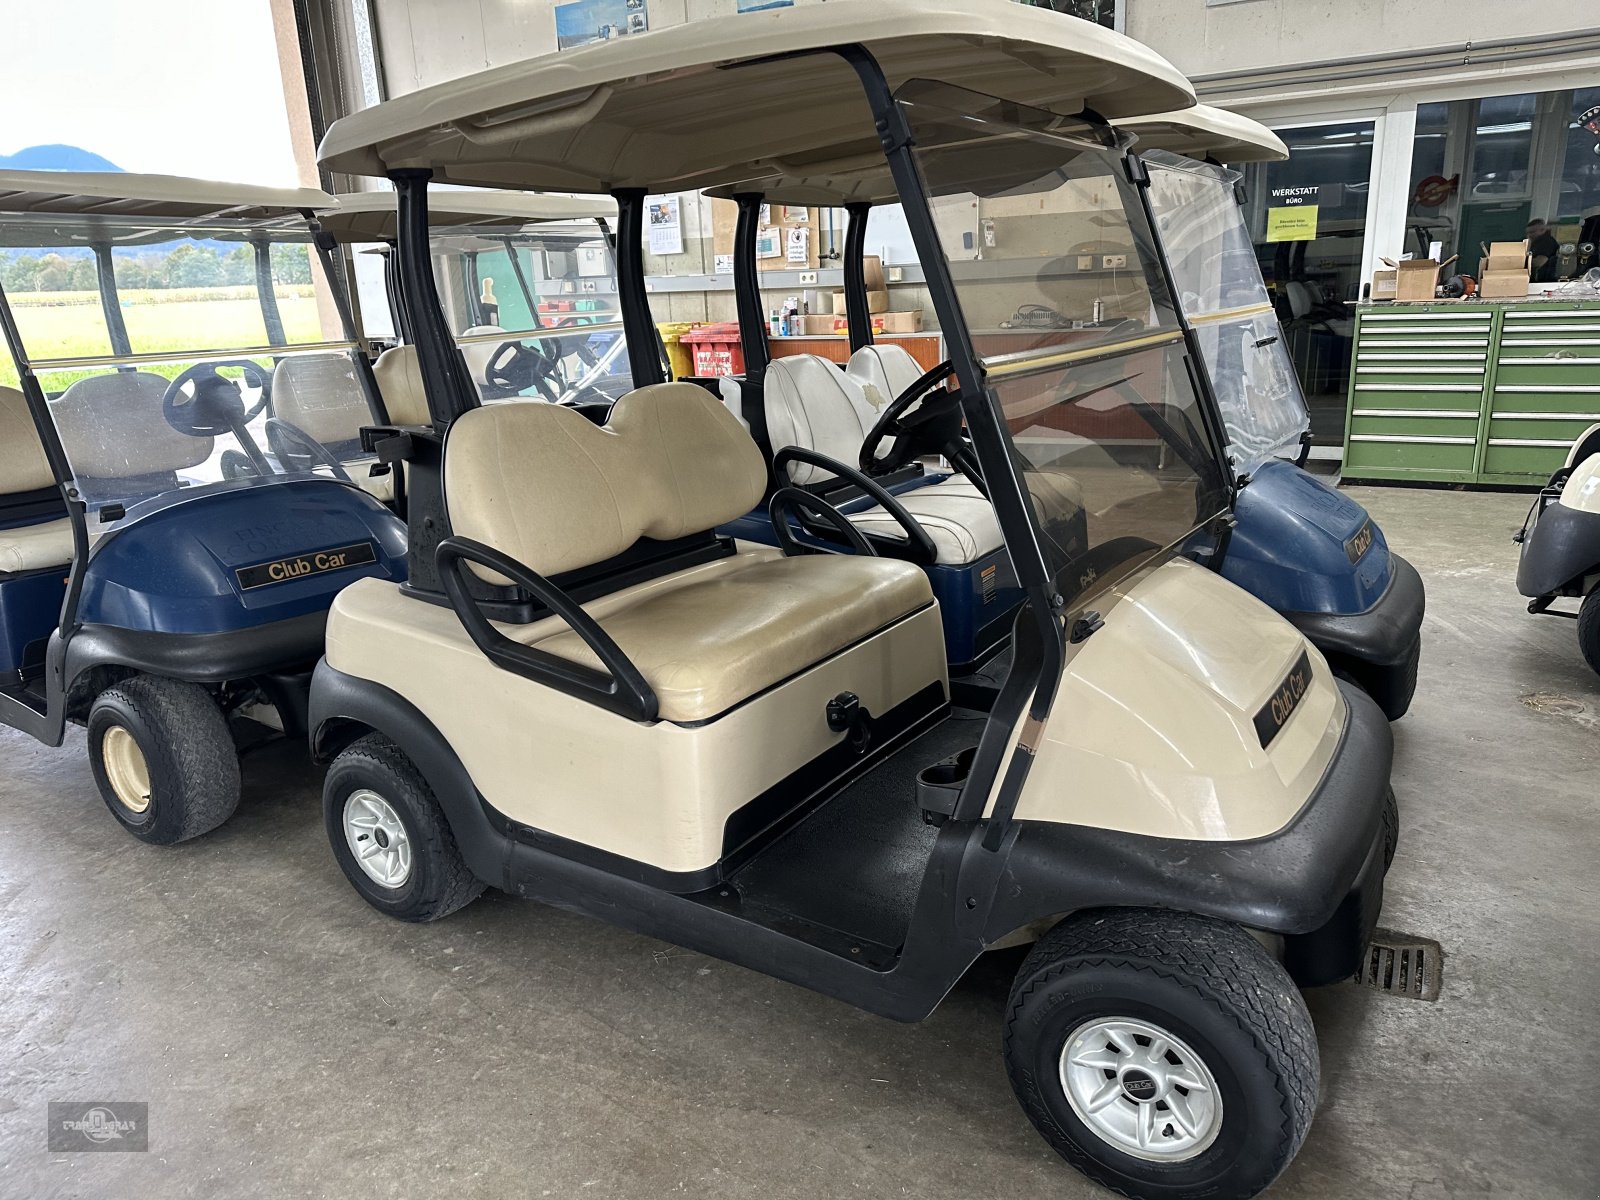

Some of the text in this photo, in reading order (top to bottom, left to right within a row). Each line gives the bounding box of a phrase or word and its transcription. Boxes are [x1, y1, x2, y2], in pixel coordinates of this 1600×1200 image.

[1271, 186, 1319, 197] WERKSTATT
[268, 552, 346, 580] Club Car
[1271, 669, 1306, 726] Club Car
